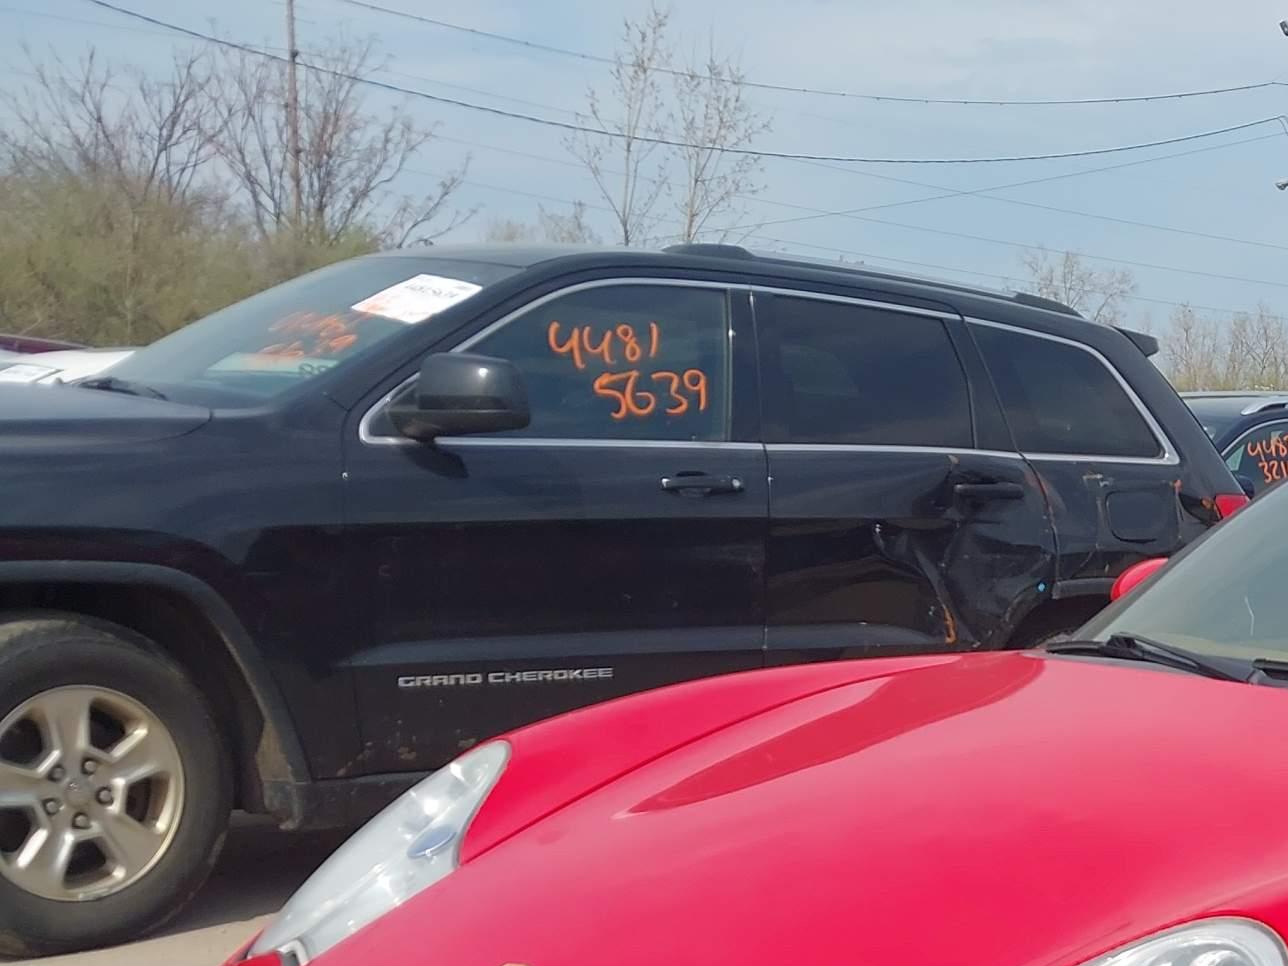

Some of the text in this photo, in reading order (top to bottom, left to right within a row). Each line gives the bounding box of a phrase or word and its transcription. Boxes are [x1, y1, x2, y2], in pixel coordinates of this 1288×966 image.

[548, 321, 660, 369] 4481
[593, 369, 707, 419] 5639
[398, 667, 613, 687] GRAND CHEROKEE
